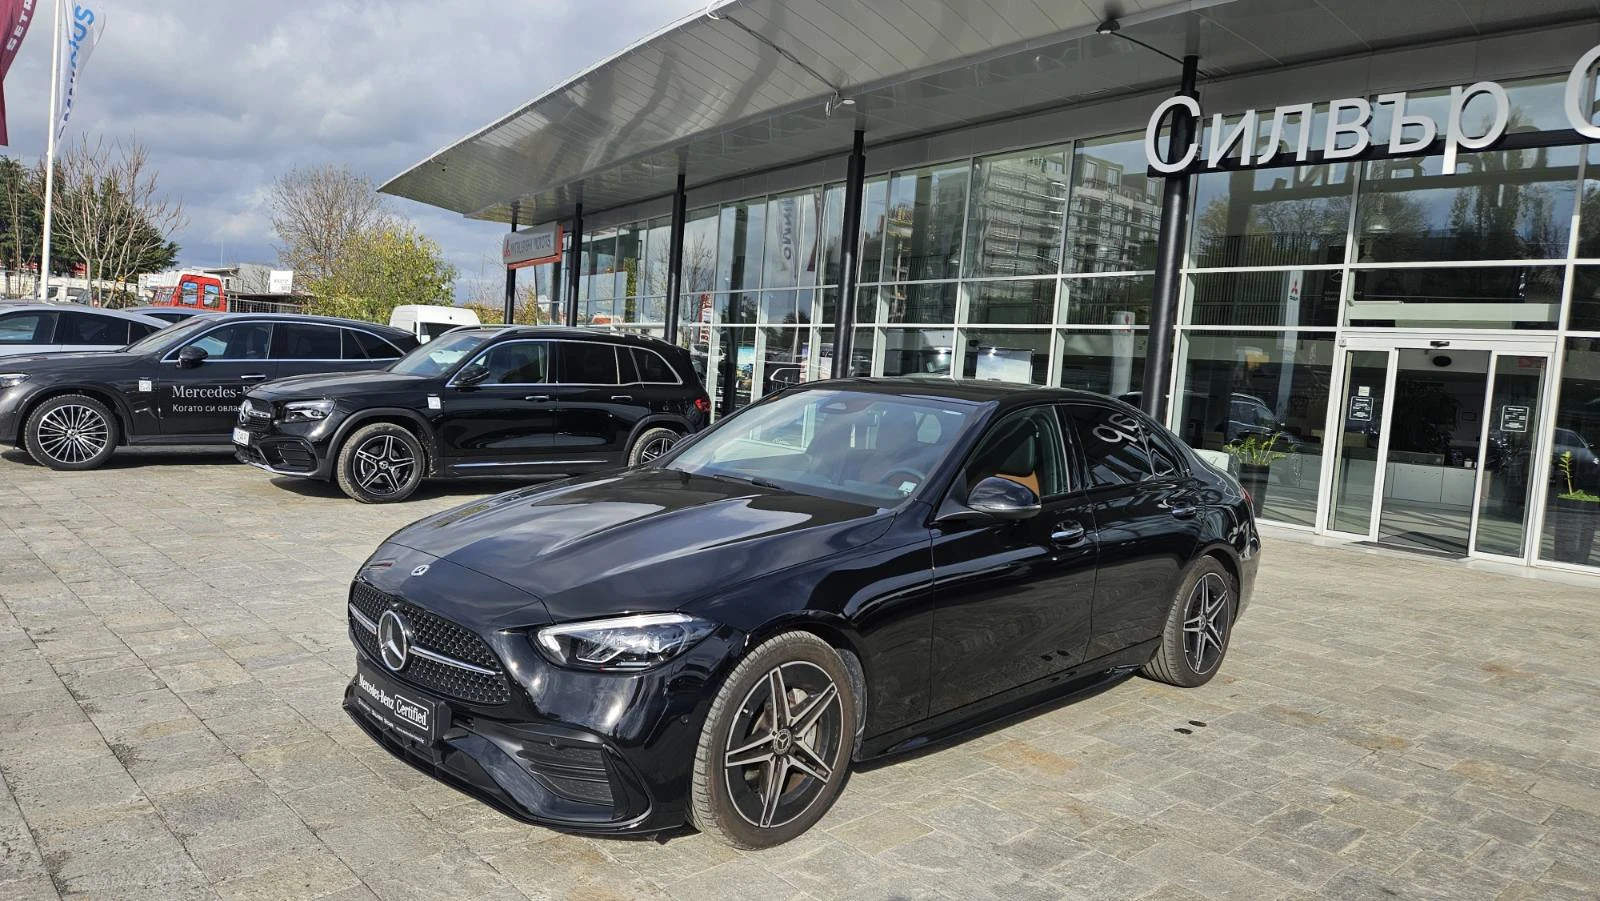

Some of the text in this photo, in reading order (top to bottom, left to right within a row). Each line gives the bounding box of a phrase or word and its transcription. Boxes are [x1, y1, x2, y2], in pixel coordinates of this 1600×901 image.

[1145, 80, 1511, 175] Силвър
[172, 403, 241, 412] Когато си овла
[358, 673, 395, 710] Mercedes-Benz
[396, 700, 427, 726] Certified
